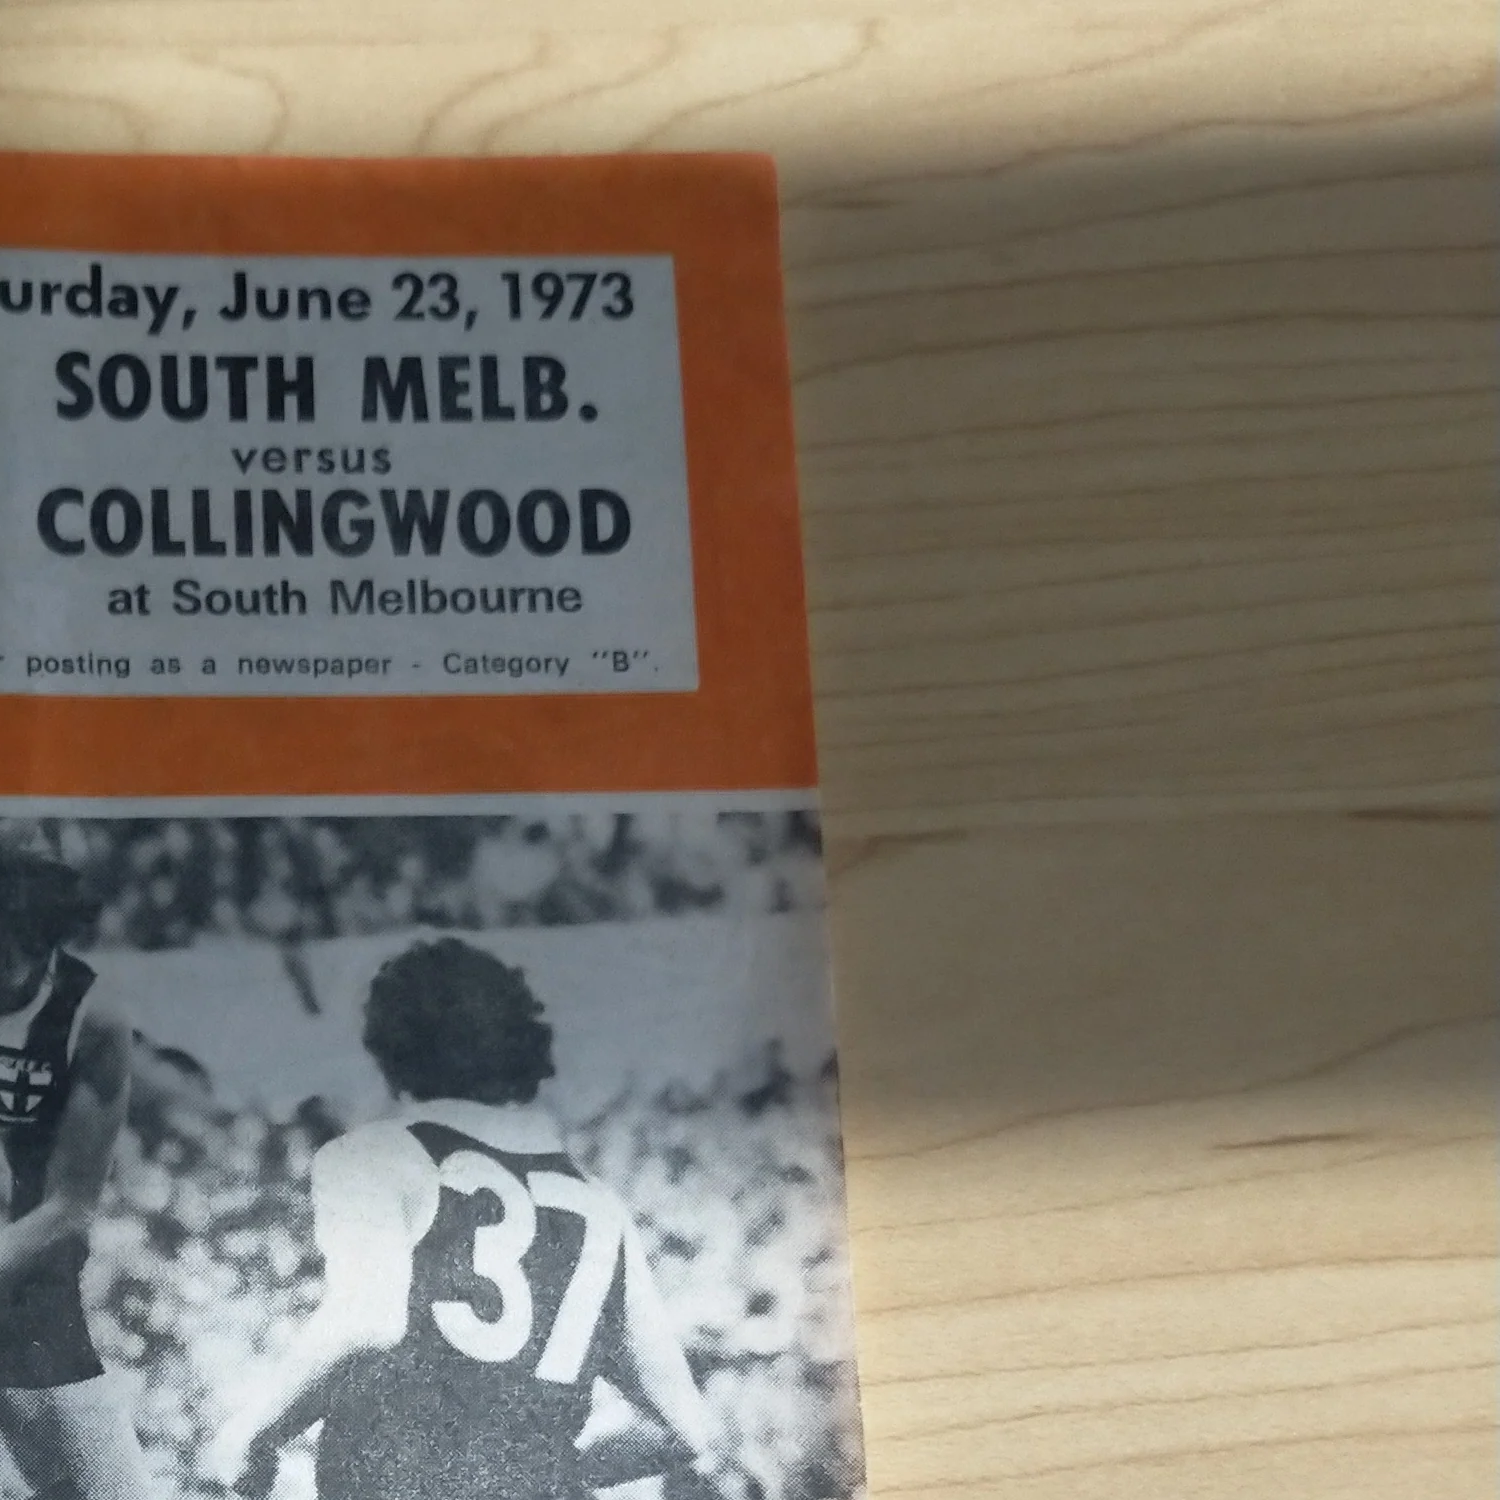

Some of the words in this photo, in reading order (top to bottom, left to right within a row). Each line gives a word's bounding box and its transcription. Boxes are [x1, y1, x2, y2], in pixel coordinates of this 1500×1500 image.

[218, 270, 373, 322] June
[391, 271, 479, 332] 23,
[500, 270, 635, 322] 1973
[54, 350, 316, 423] SOUTH
[361, 353, 600, 424] MELB.
[230, 444, 393, 476] versus
[36, 485, 632, 558] COLLINGWOOD
[107, 582, 152, 617] at
[172, 577, 308, 617] South
[329, 577, 584, 616] Melbourne
[25, 651, 131, 679] posting
[148, 656, 183, 676] as
[200, 655, 218, 676] a
[237, 655, 393, 679] newspaper
[441, 650, 571, 678] Category
[431, 1149, 623, 1385] 37
